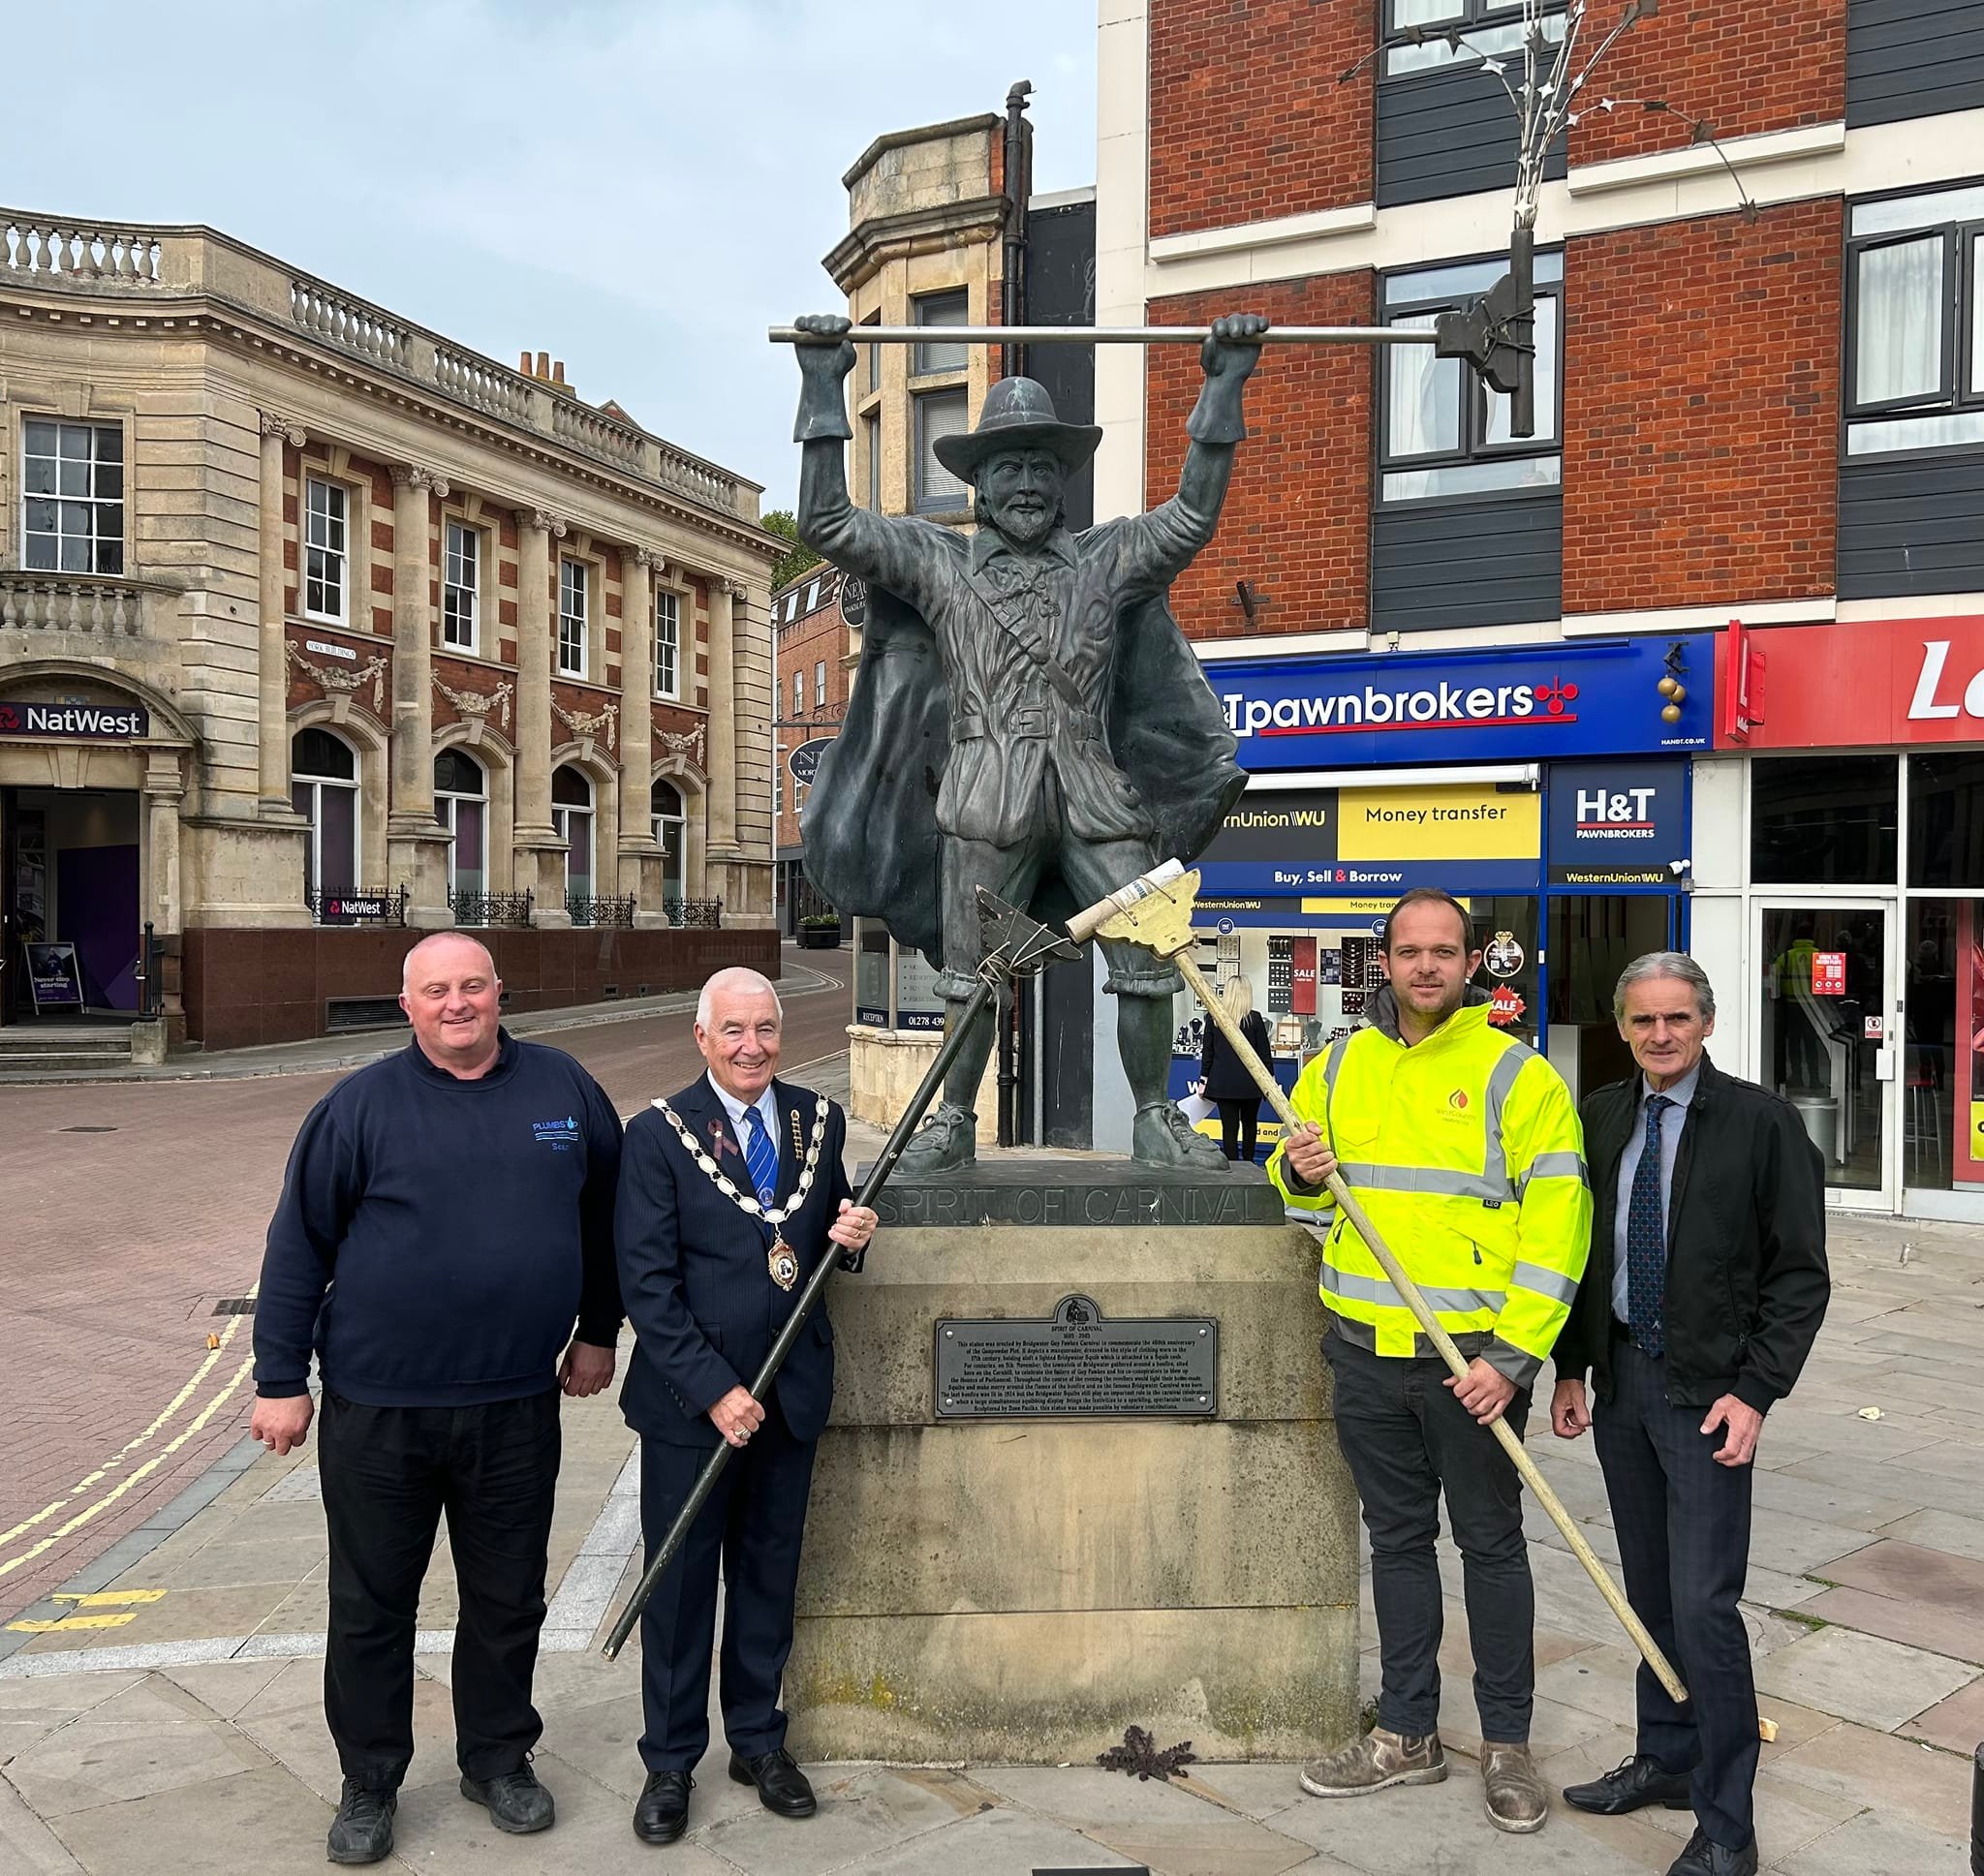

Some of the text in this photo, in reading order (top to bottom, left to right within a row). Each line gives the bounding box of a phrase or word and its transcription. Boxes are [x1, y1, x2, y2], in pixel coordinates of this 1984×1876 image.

[308, 642, 324, 652] YORK
[1246, 682, 1534, 737] pawnbrokers
[27, 708, 140, 734] NatWest
[1577, 788, 1656, 822] H&T
[1366, 805, 1507, 824] Money transfer
[1576, 829, 1655, 839] PAWNBROKERS
[1274, 869, 1402, 886] Buy, Sell & Borrow
[341, 900, 381, 915] NatWest
[1350, 901, 1377, 909] Money
[1294, 969, 1316, 978] SALE
[863, 1012, 884, 1023] RECEPTION
[908, 1016, 930, 1026] 01278
[877, 1187, 1264, 1225] SPIRIT OF CARNIVAL
